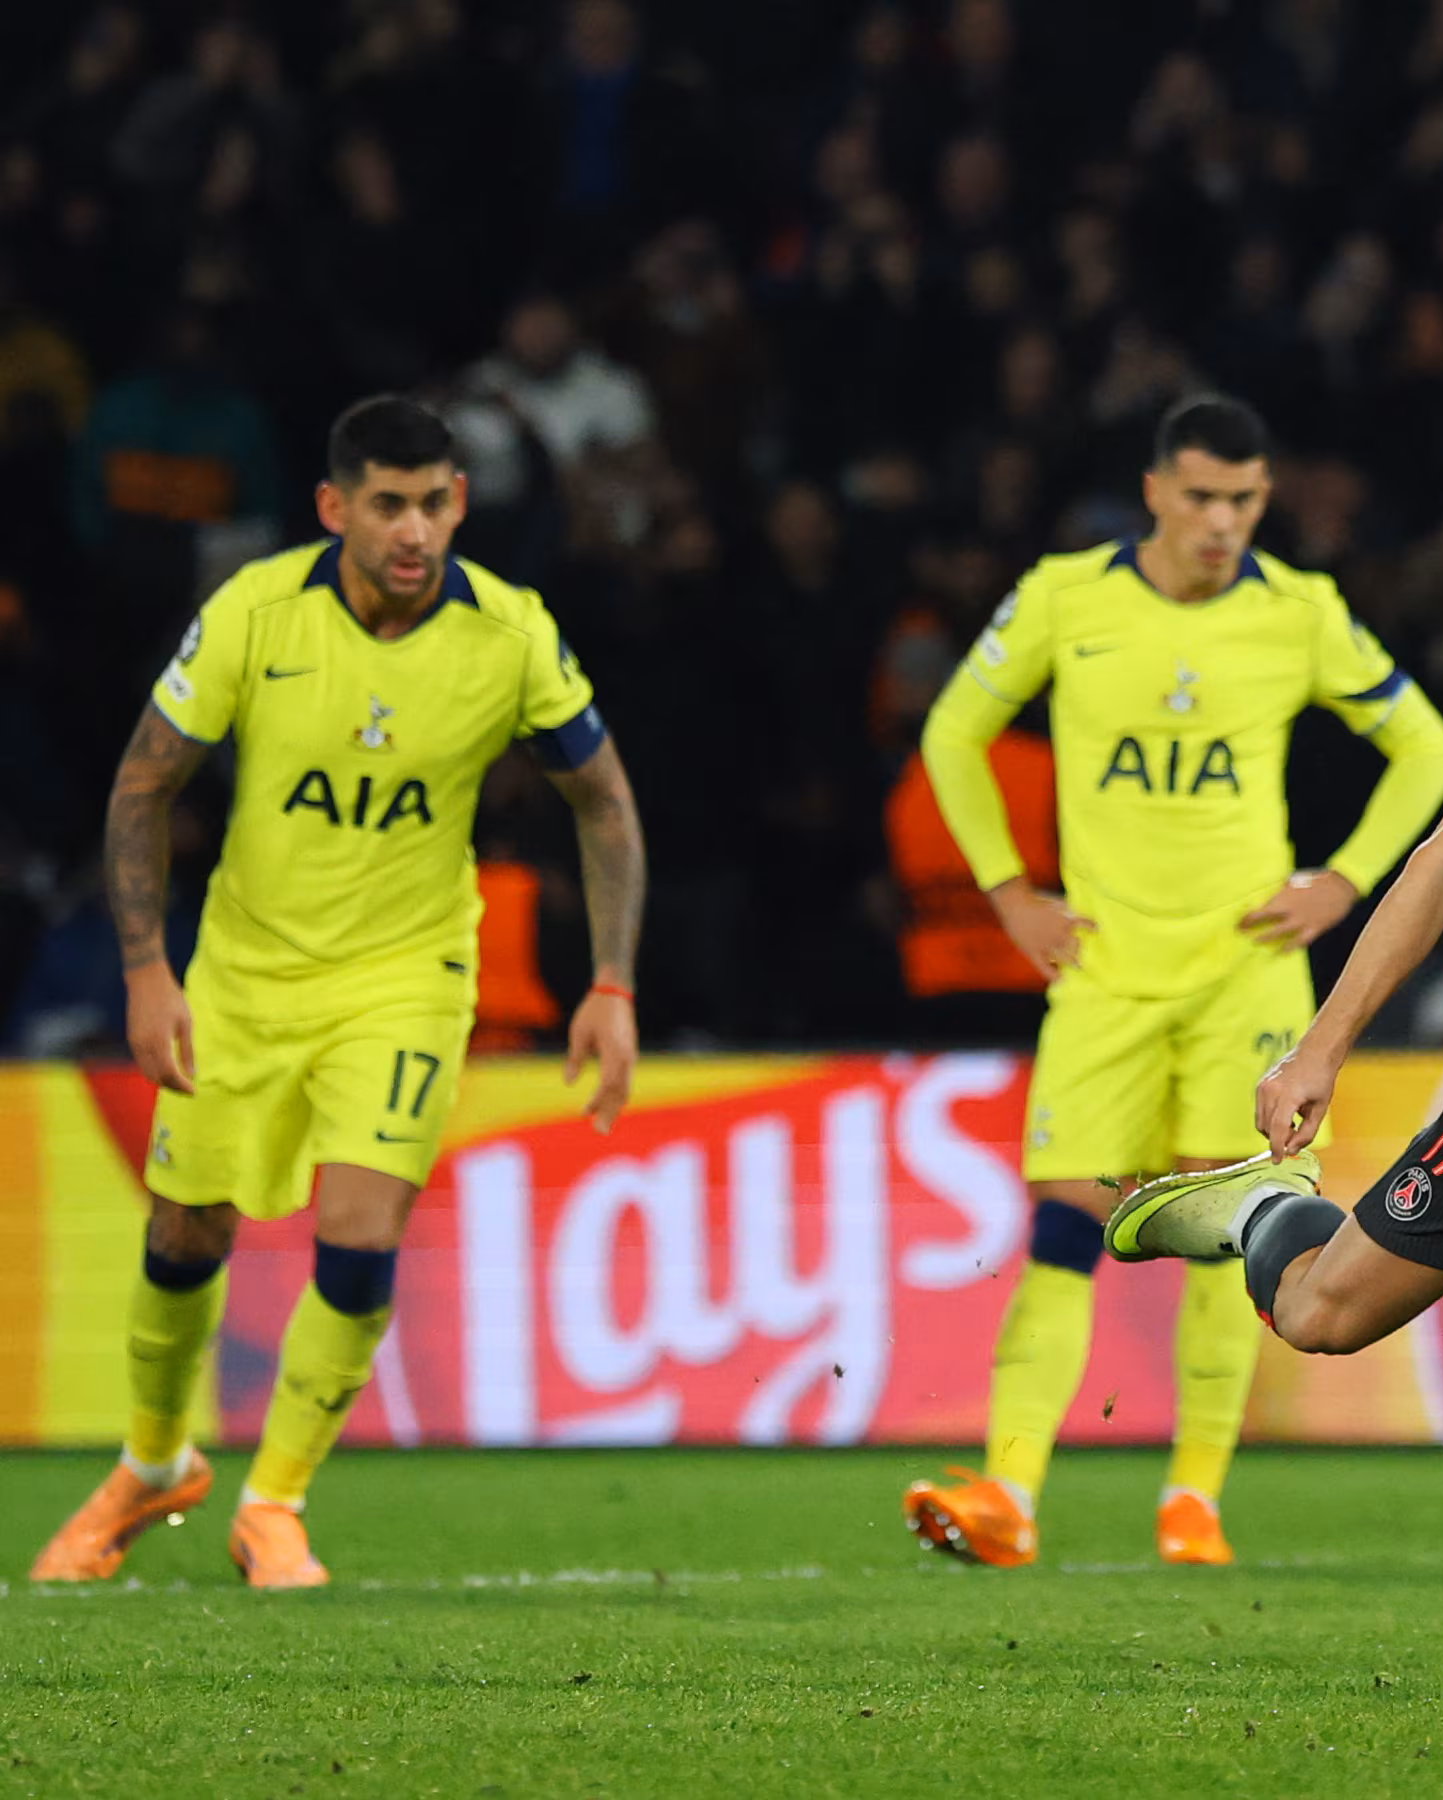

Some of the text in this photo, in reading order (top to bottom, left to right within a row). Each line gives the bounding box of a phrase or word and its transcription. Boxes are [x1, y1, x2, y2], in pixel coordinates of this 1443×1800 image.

[1098, 735, 1240, 797] AIA
[283, 768, 433, 832] AIA
[386, 1049, 442, 1120] 17
[1407, 1169, 1430, 1192] PARIS
